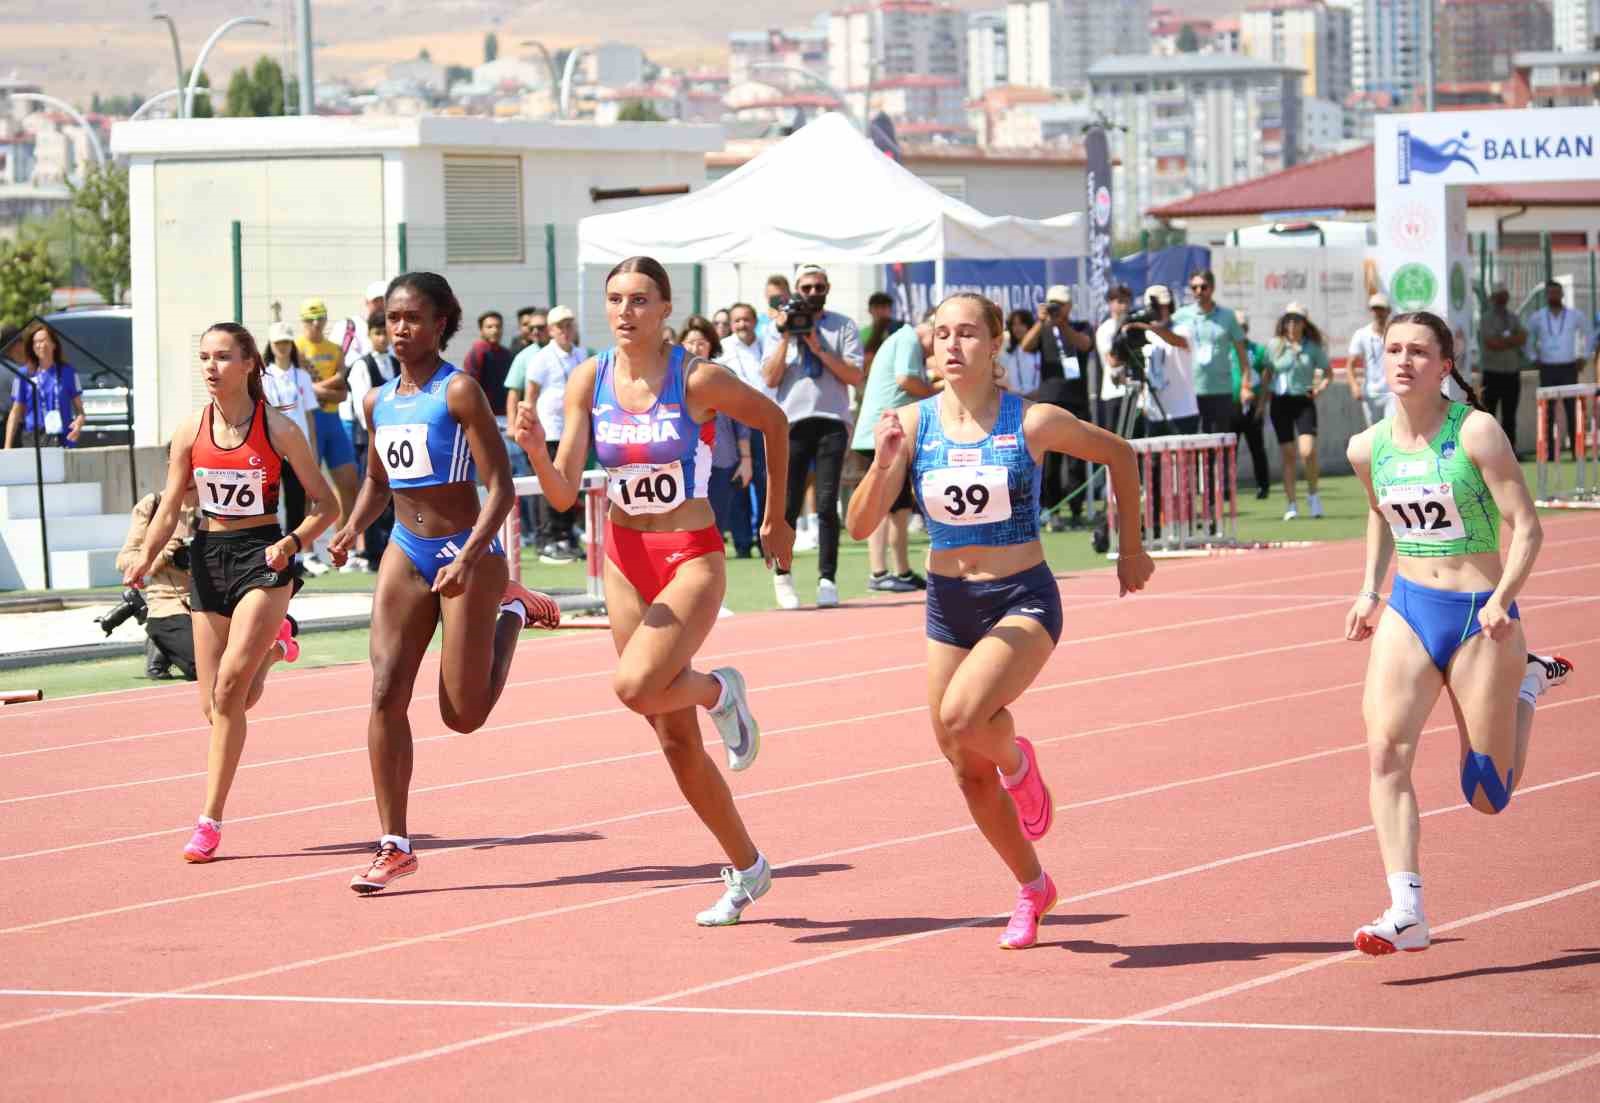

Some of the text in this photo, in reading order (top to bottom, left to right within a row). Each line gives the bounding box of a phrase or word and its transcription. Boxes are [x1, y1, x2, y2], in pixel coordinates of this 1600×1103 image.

[1484, 135, 1594, 160] BALKAN
[595, 420, 681, 444] SERBIA
[387, 440, 414, 469] 60
[207, 482, 256, 508] 176
[619, 473, 677, 505] 140
[944, 484, 990, 516] 39
[1391, 501, 1452, 530] 112
